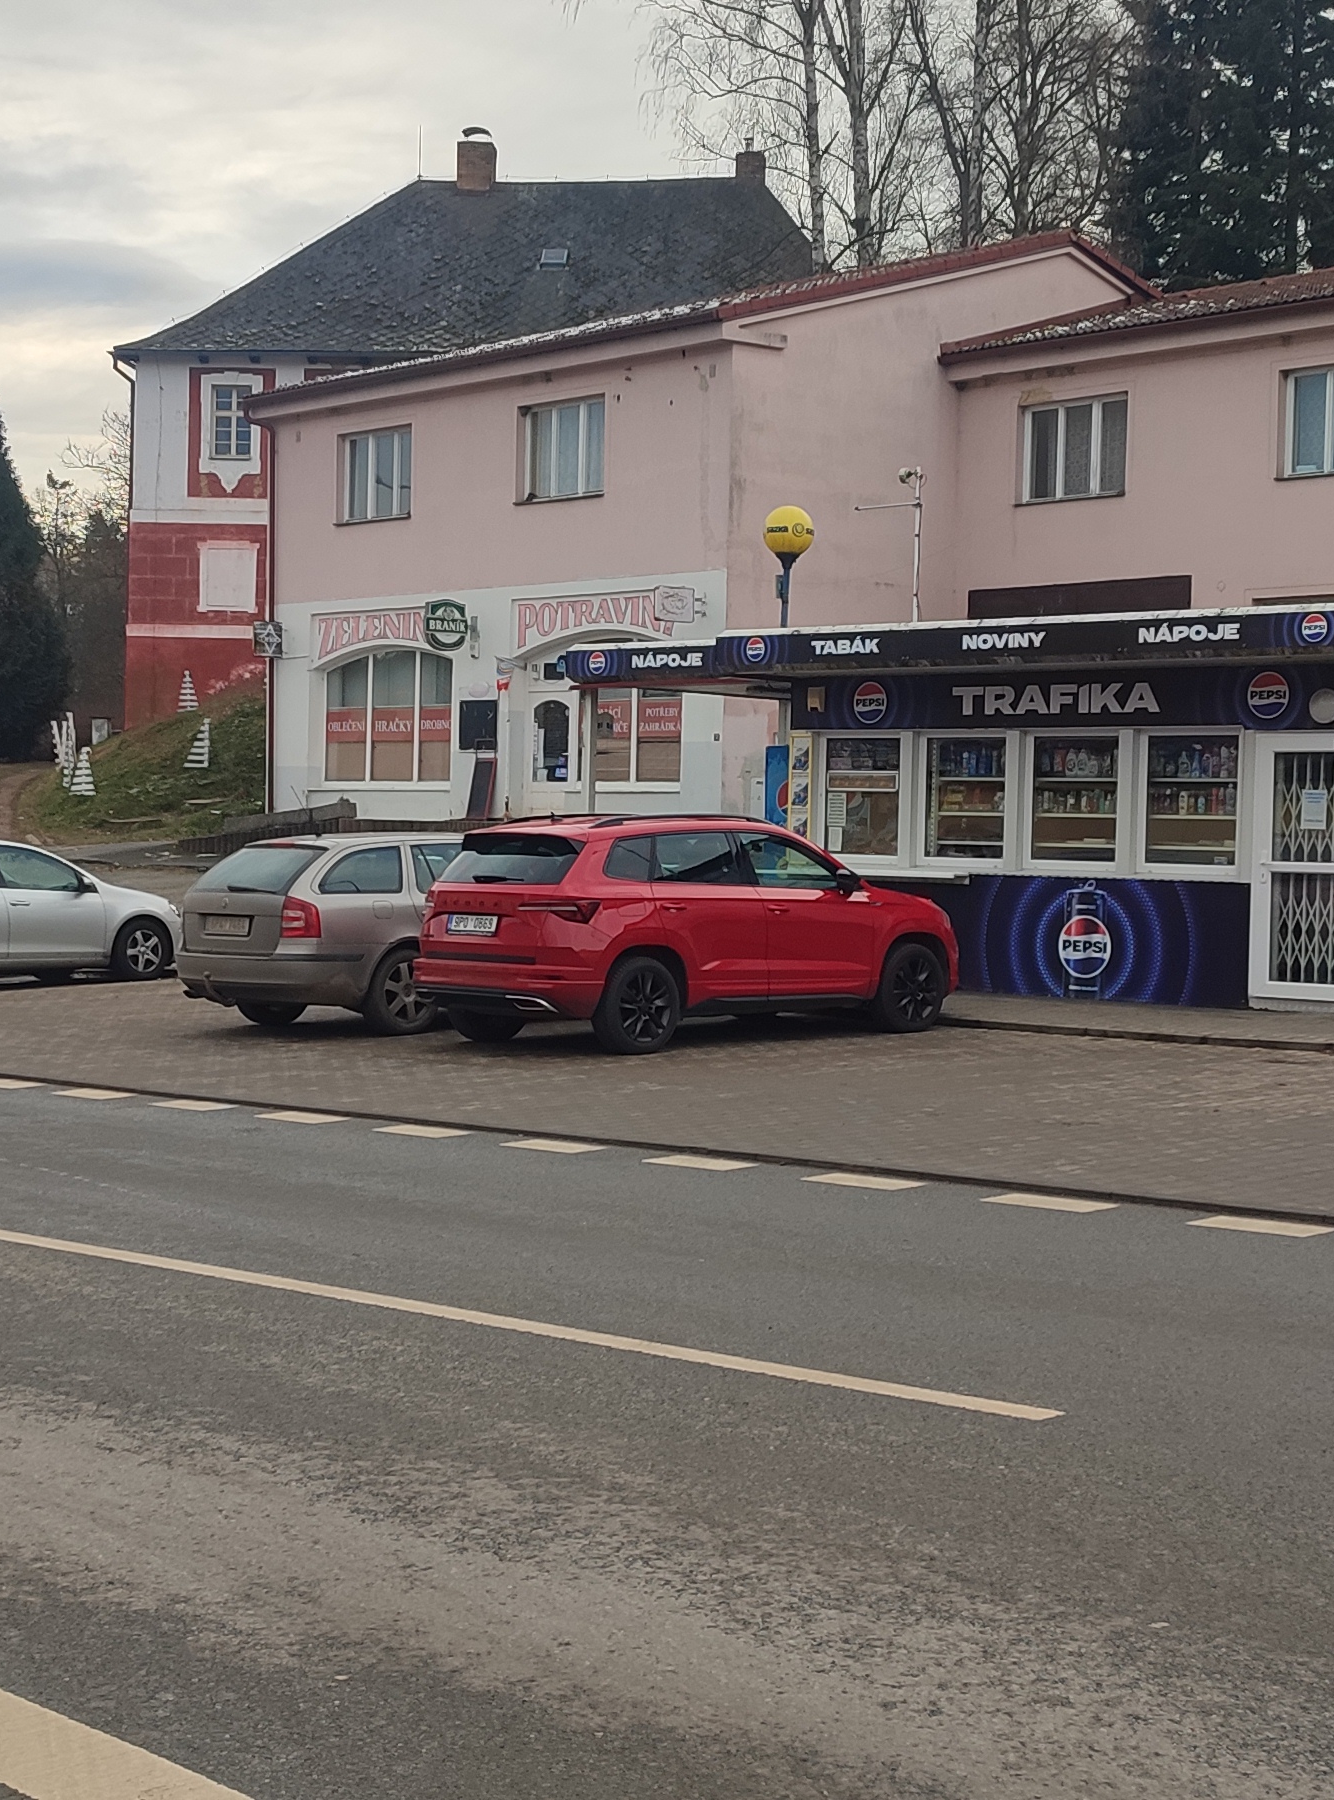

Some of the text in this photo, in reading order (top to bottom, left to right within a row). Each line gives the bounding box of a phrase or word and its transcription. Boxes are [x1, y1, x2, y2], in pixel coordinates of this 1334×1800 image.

[429, 618, 466, 633] BRANÍK
[318, 612, 427, 660] ZELENIN
[811, 621, 1240, 655] TABÁK NOVINY NÁPOJE
[631, 651, 703, 669] NÁPOJE
[856, 698, 885, 707] PEPSI
[952, 682, 1161, 716] TRAFIKA
[1250, 690, 1287, 700] PEPSI
[646, 706, 679, 717] POTŘEBY
[375, 718, 412, 732] HRAČKY
[1062, 939, 1107, 954] PEPSI
